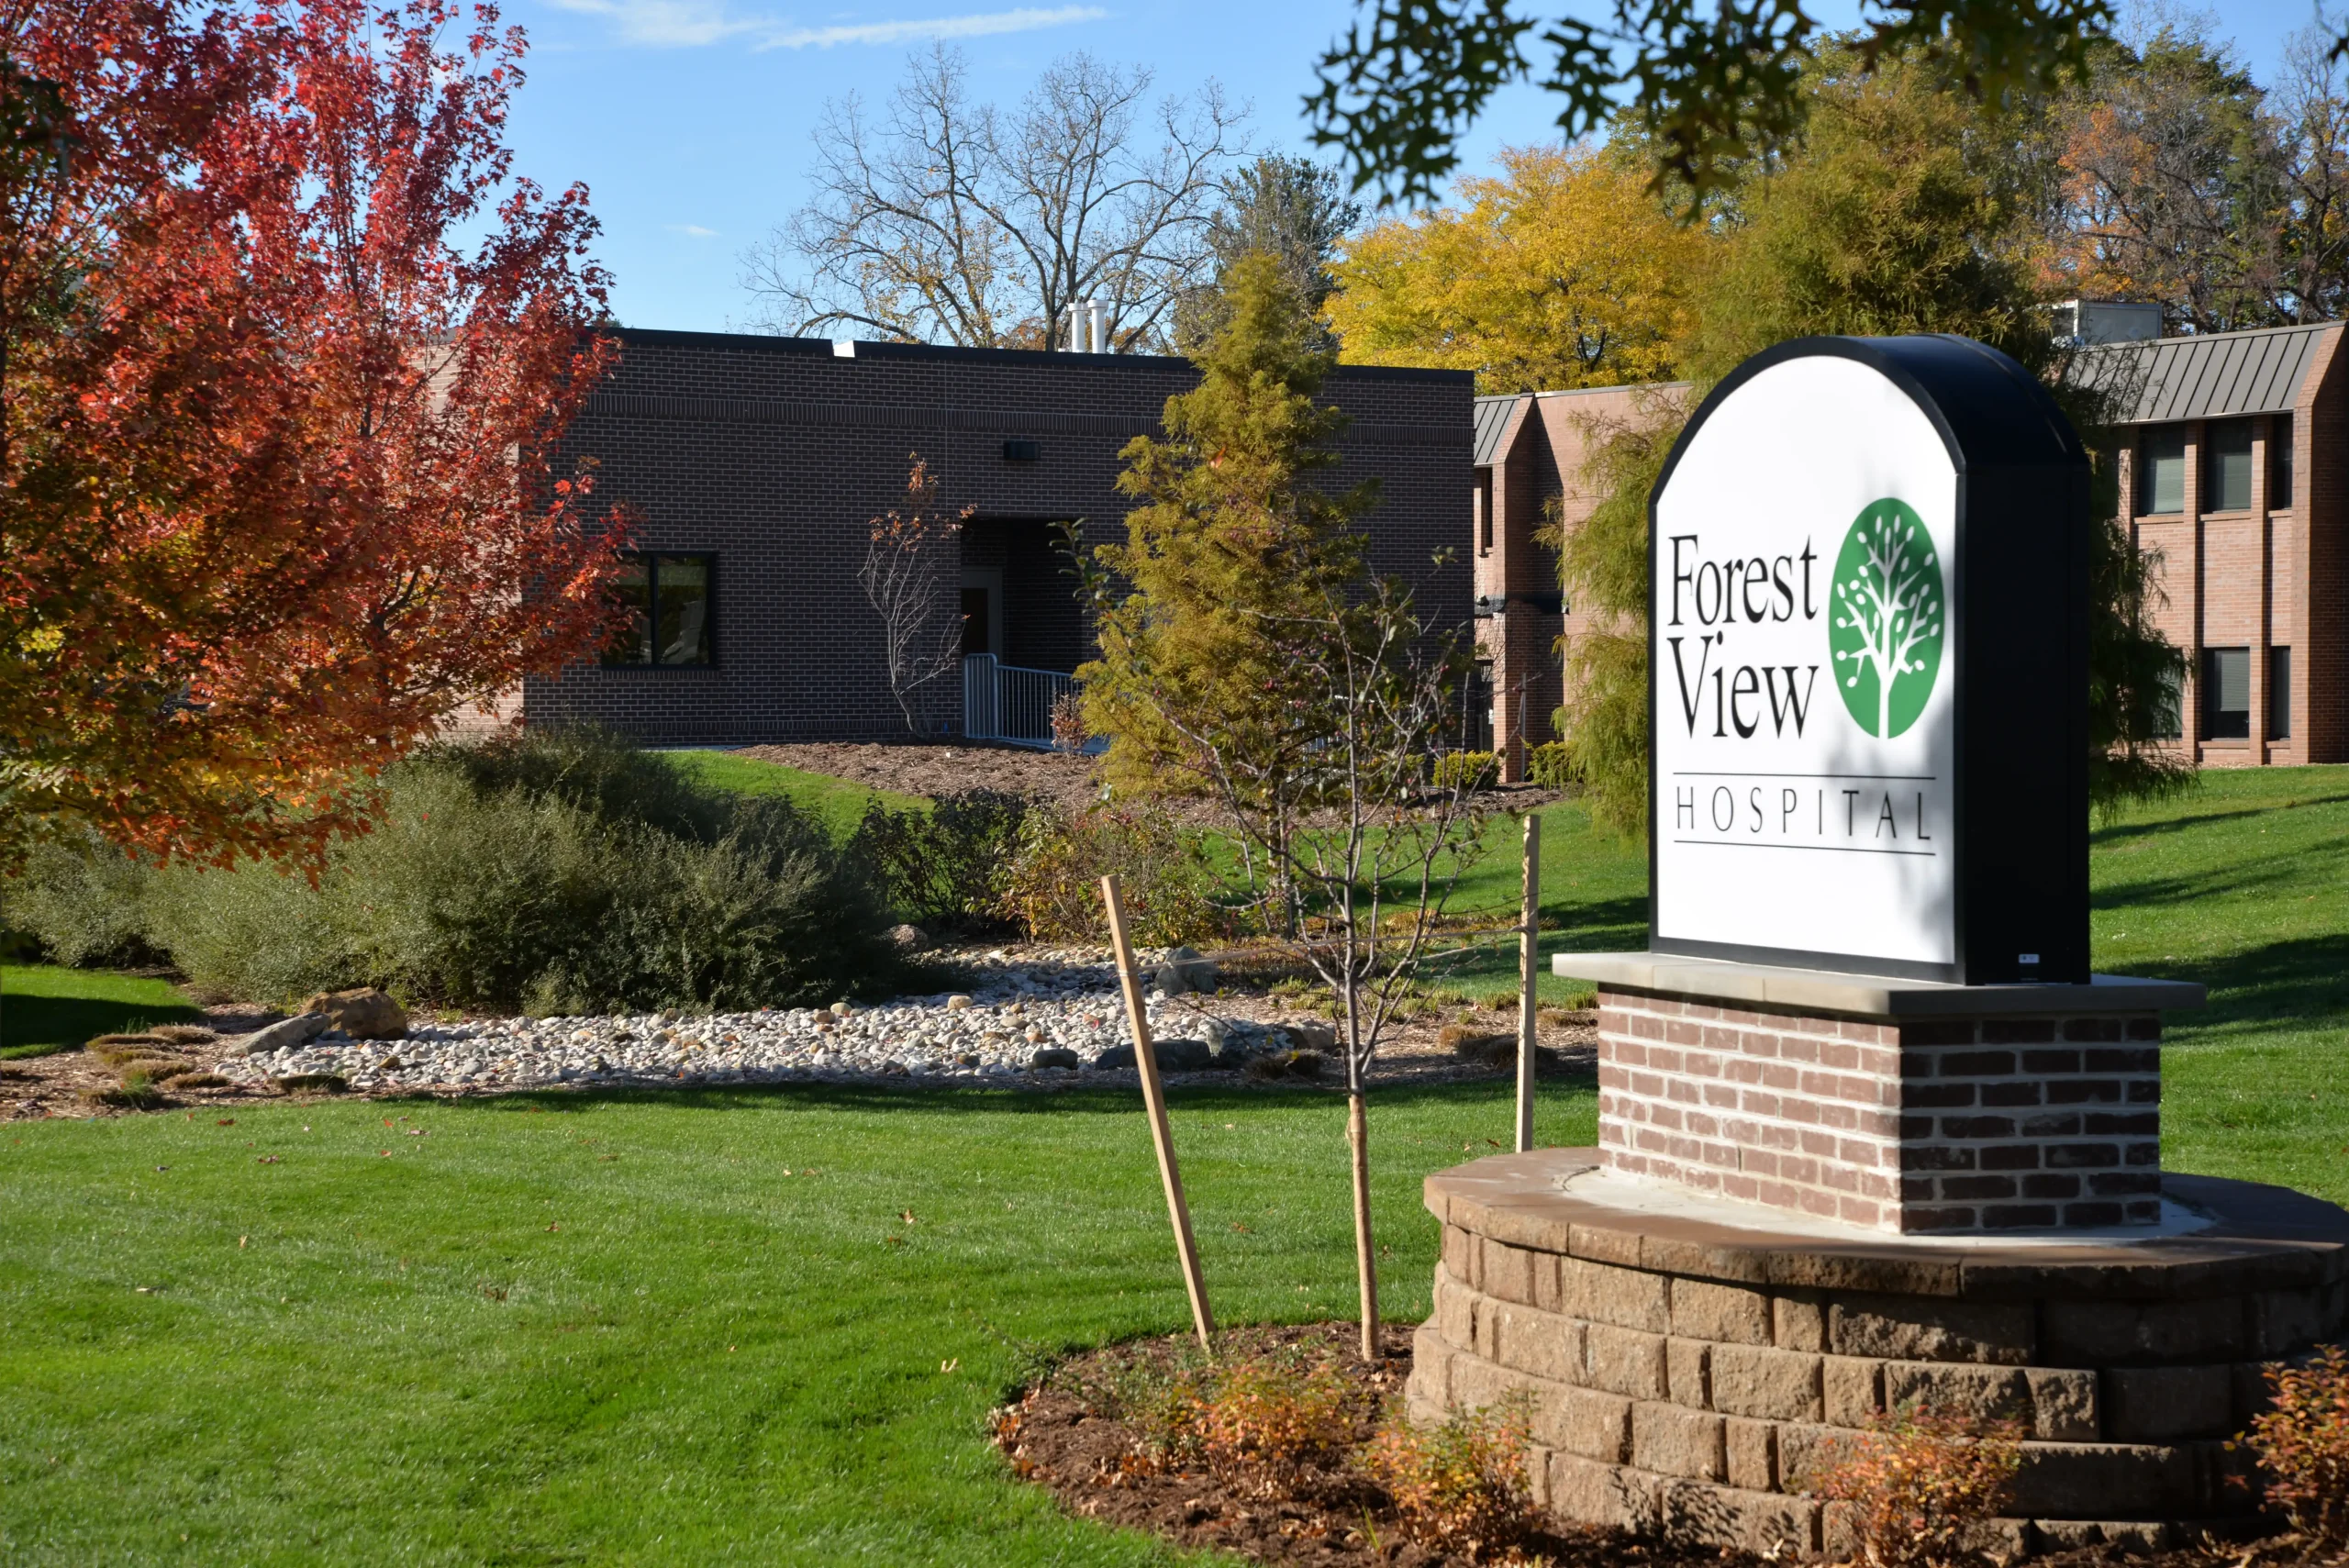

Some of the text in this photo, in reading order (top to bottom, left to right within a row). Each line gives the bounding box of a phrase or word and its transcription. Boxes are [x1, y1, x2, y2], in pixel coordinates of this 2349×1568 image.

[1668, 534, 1819, 626] Forest
[1666, 630, 1820, 739] View
[1676, 786, 1931, 840] HOSPITAL
